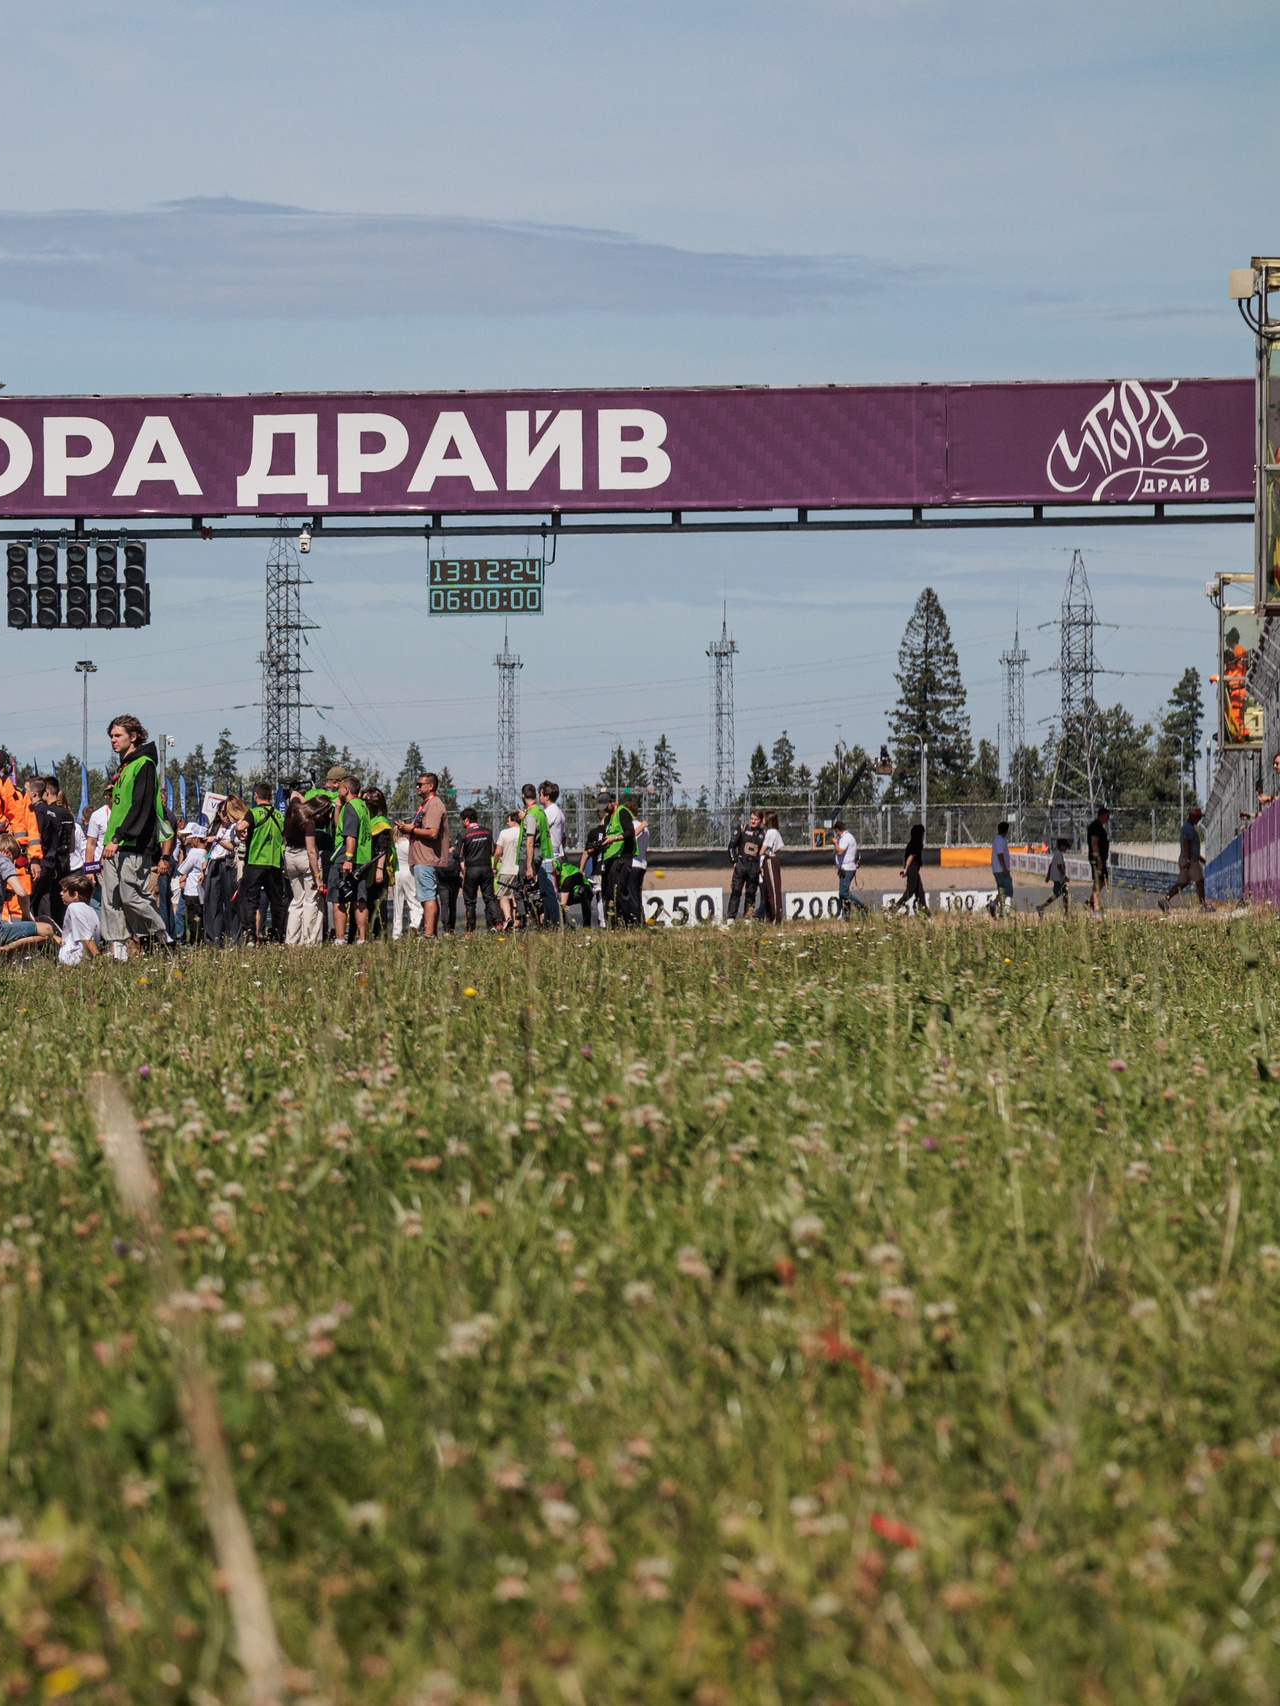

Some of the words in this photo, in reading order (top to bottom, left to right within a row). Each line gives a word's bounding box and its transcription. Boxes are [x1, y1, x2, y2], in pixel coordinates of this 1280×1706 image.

[236, 408, 672, 509] ДРАЙВ
[1141, 475, 1210, 493] ДРАЙВ
[433, 561, 540, 582] 13:12:24
[431, 589, 540, 610] 06:00:00
[646, 895, 716, 926] 250
[792, 896, 842, 920] 200
[946, 895, 975, 913] 100
